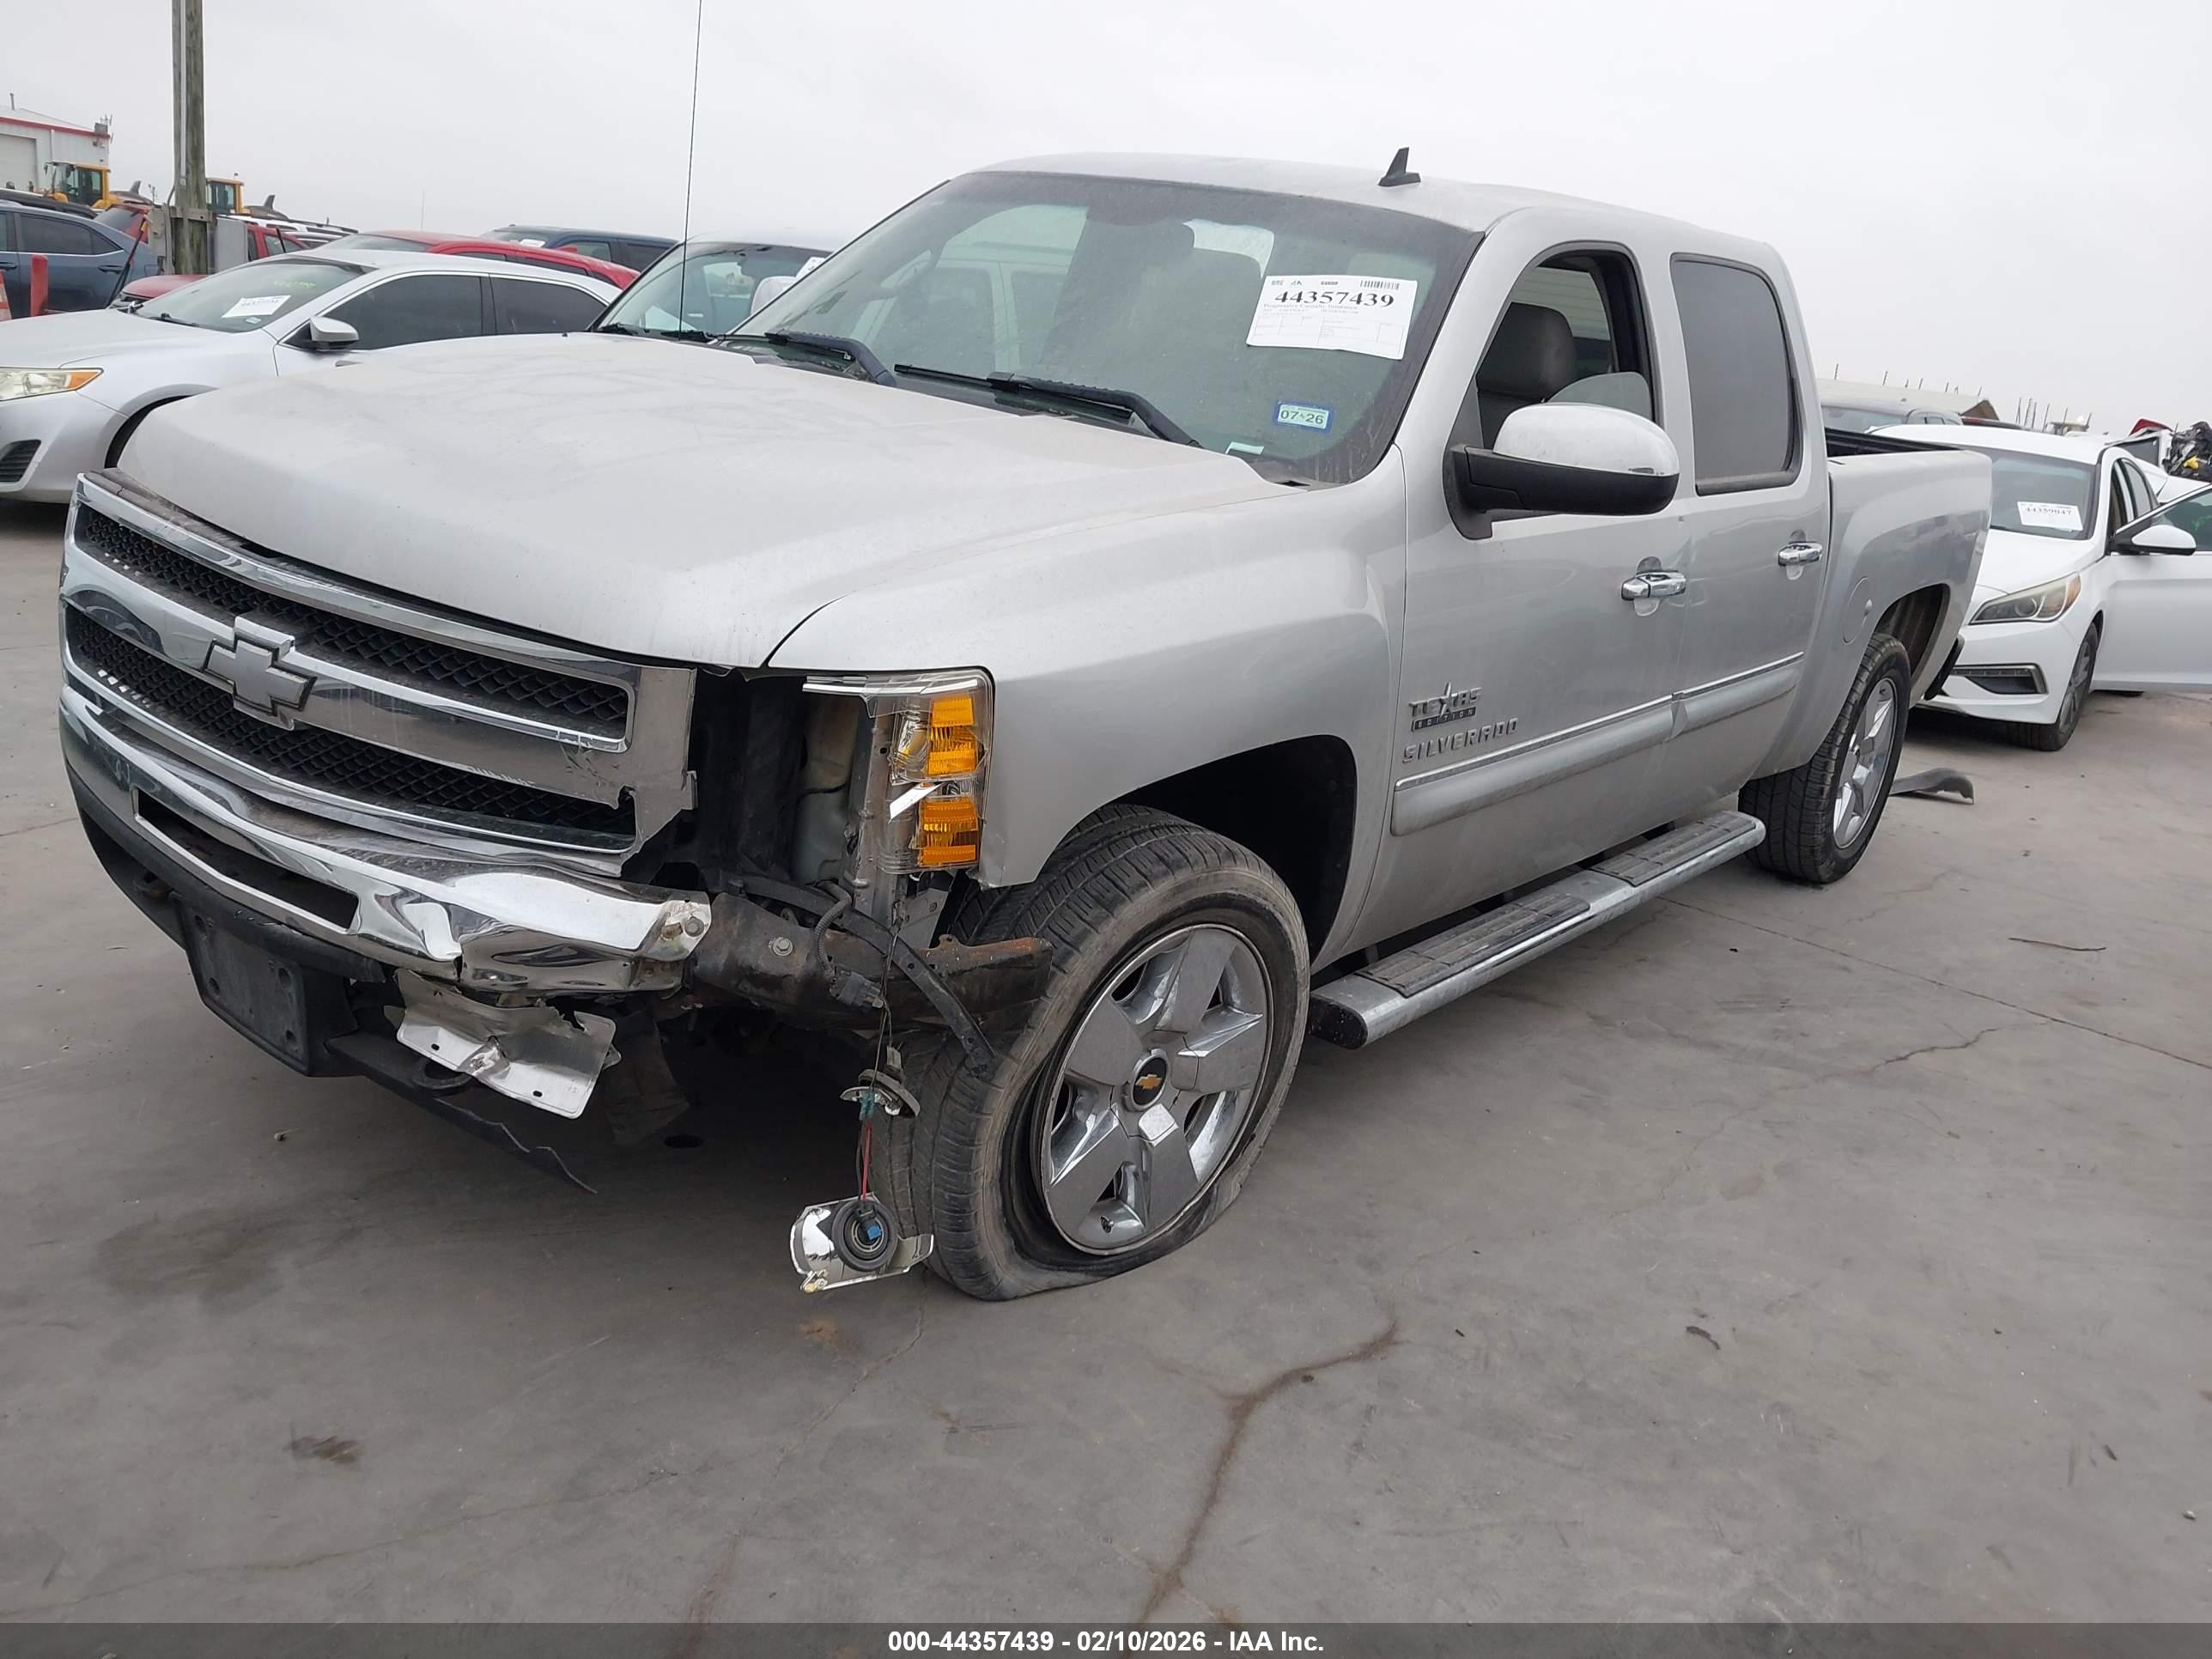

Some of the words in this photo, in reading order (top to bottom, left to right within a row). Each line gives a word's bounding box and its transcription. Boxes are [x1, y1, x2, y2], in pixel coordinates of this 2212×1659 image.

[1274, 290, 1395, 307] 44357439
[1408, 682, 1482, 716] TEXAS
[1416, 709, 1475, 729] EDITION
[1402, 718, 1519, 763] SILVERADO
